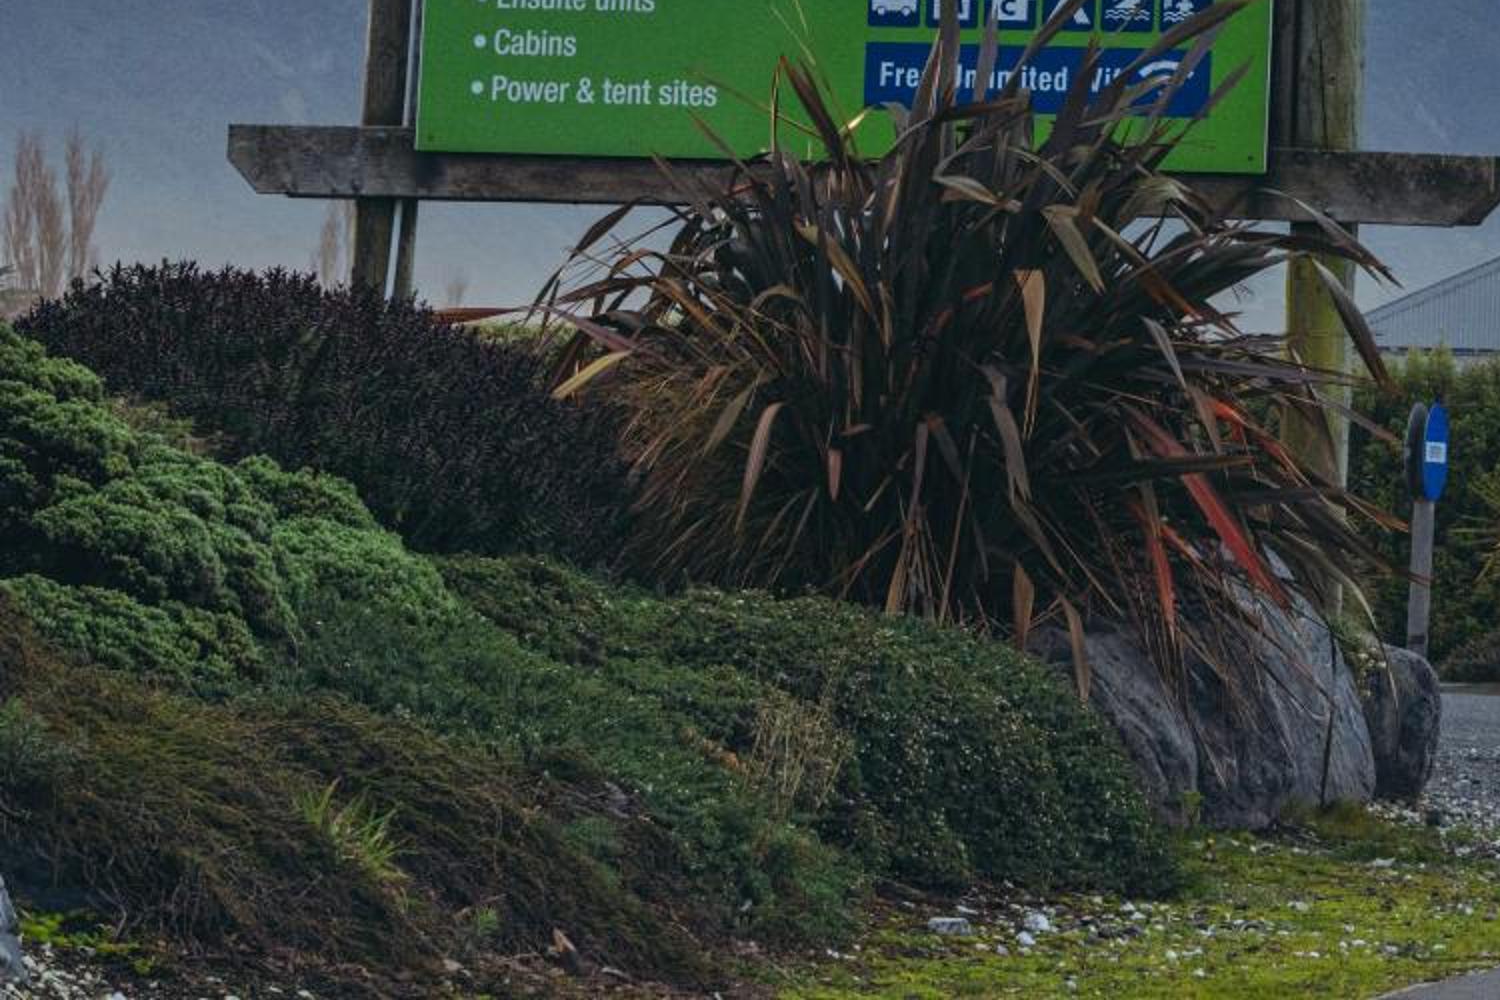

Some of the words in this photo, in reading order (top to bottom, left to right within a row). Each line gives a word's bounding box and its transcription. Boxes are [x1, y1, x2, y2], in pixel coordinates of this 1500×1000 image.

[494, 29, 577, 57] Cabins
[879, 61, 932, 87] Fre
[491, 75, 570, 103] Power
[575, 77, 595, 104] &
[602, 77, 652, 105] tent
[658, 79, 718, 107] sites
